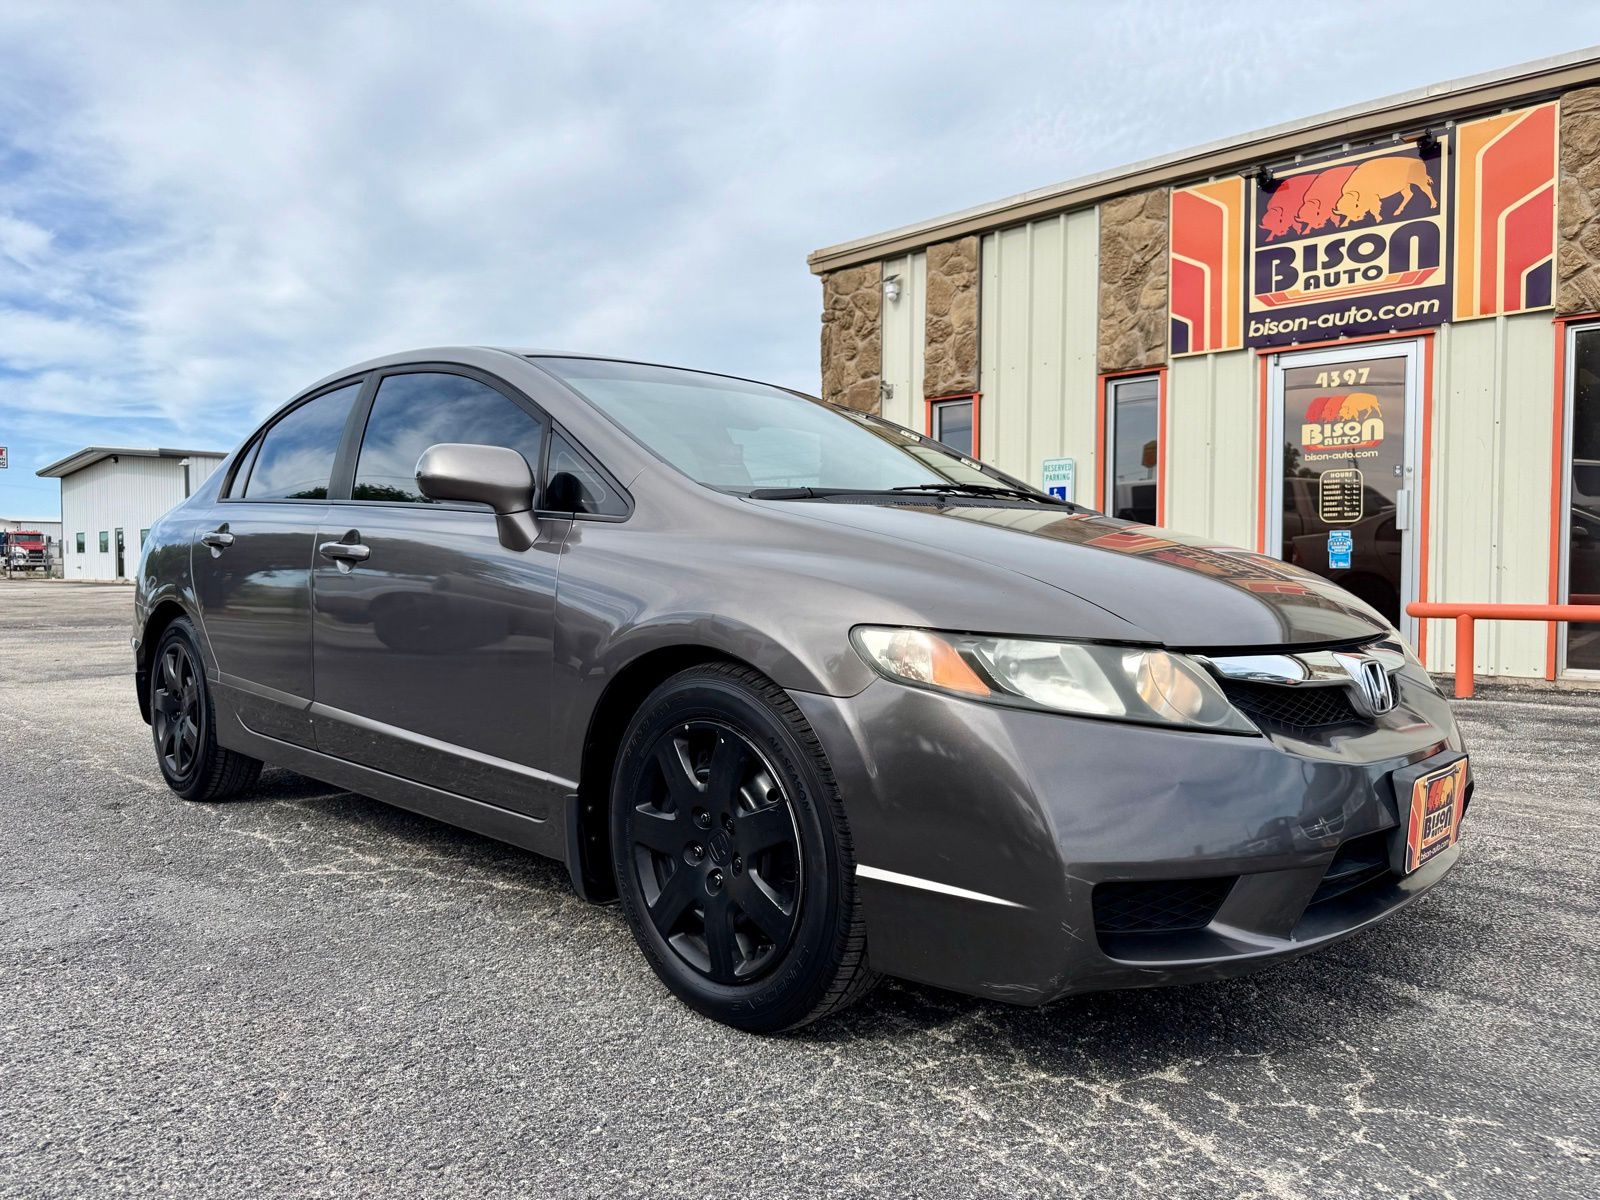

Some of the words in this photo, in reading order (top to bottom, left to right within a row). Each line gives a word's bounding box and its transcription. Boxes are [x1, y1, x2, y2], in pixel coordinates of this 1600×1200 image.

[1255, 220, 1440, 295] BISON
[1304, 264, 1383, 290] AUTO
[1248, 298, 1439, 337] bison-auto.com
[1315, 367, 1370, 388] 4397
[1301, 418, 1384, 446] BISON
[1324, 436, 1359, 446] AUTO
[1044, 464, 1072, 472] RESERVED
[1304, 450, 1378, 461] bison-auto.com
[783, 757, 812, 812] SEASON
[1423, 806, 1452, 840] BISON
[1431, 827, 1444, 838] AUTO
